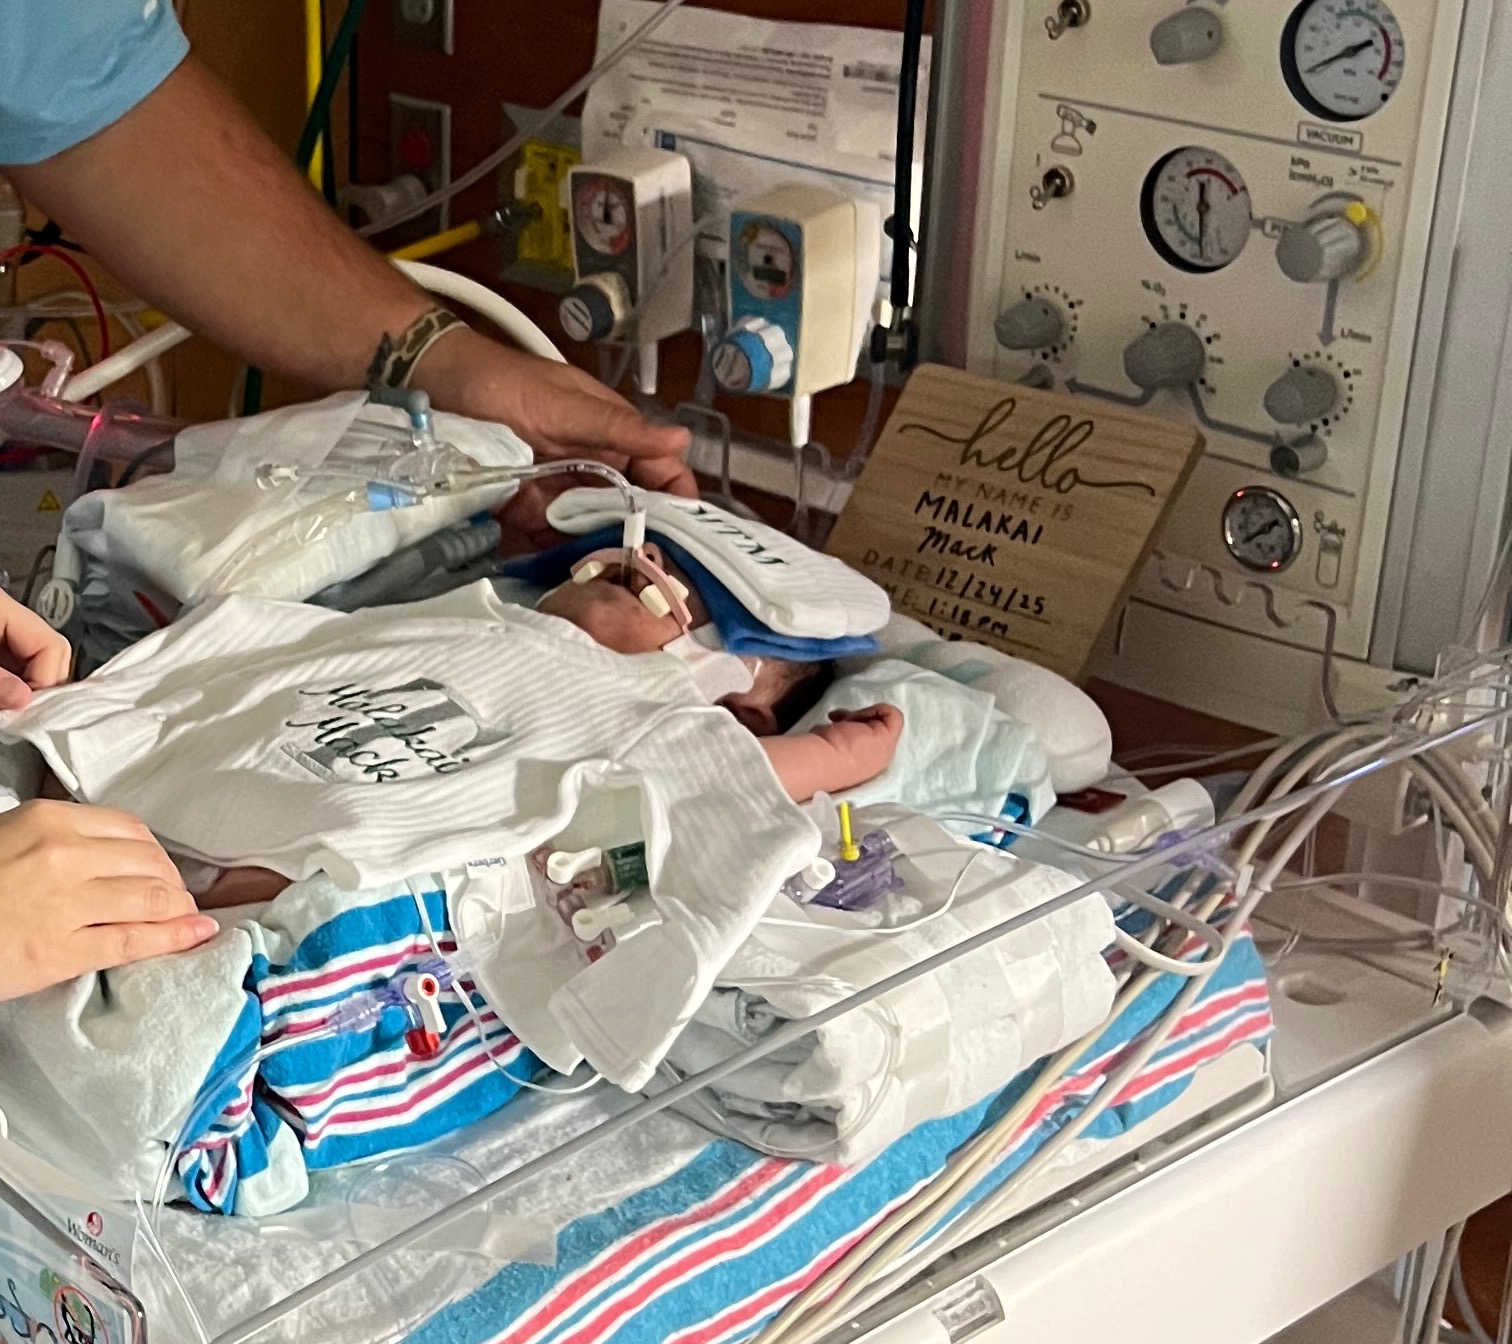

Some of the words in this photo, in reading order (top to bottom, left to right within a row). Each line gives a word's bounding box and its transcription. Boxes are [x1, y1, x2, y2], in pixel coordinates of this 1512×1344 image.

[1305, 127, 1355, 147] VACUUM
[896, 397, 1156, 497] hello
[936, 471, 966, 493] MY
[978, 482, 1039, 514] NAME
[914, 490, 1044, 546] MALAKAI
[917, 526, 1000, 567] Mack
[935, 566, 1046, 616] 12/24/25
[285, 716, 410, 784] Mack
[298, 683, 471, 775] Malakai
[66, 1217, 122, 1267] Woman's
